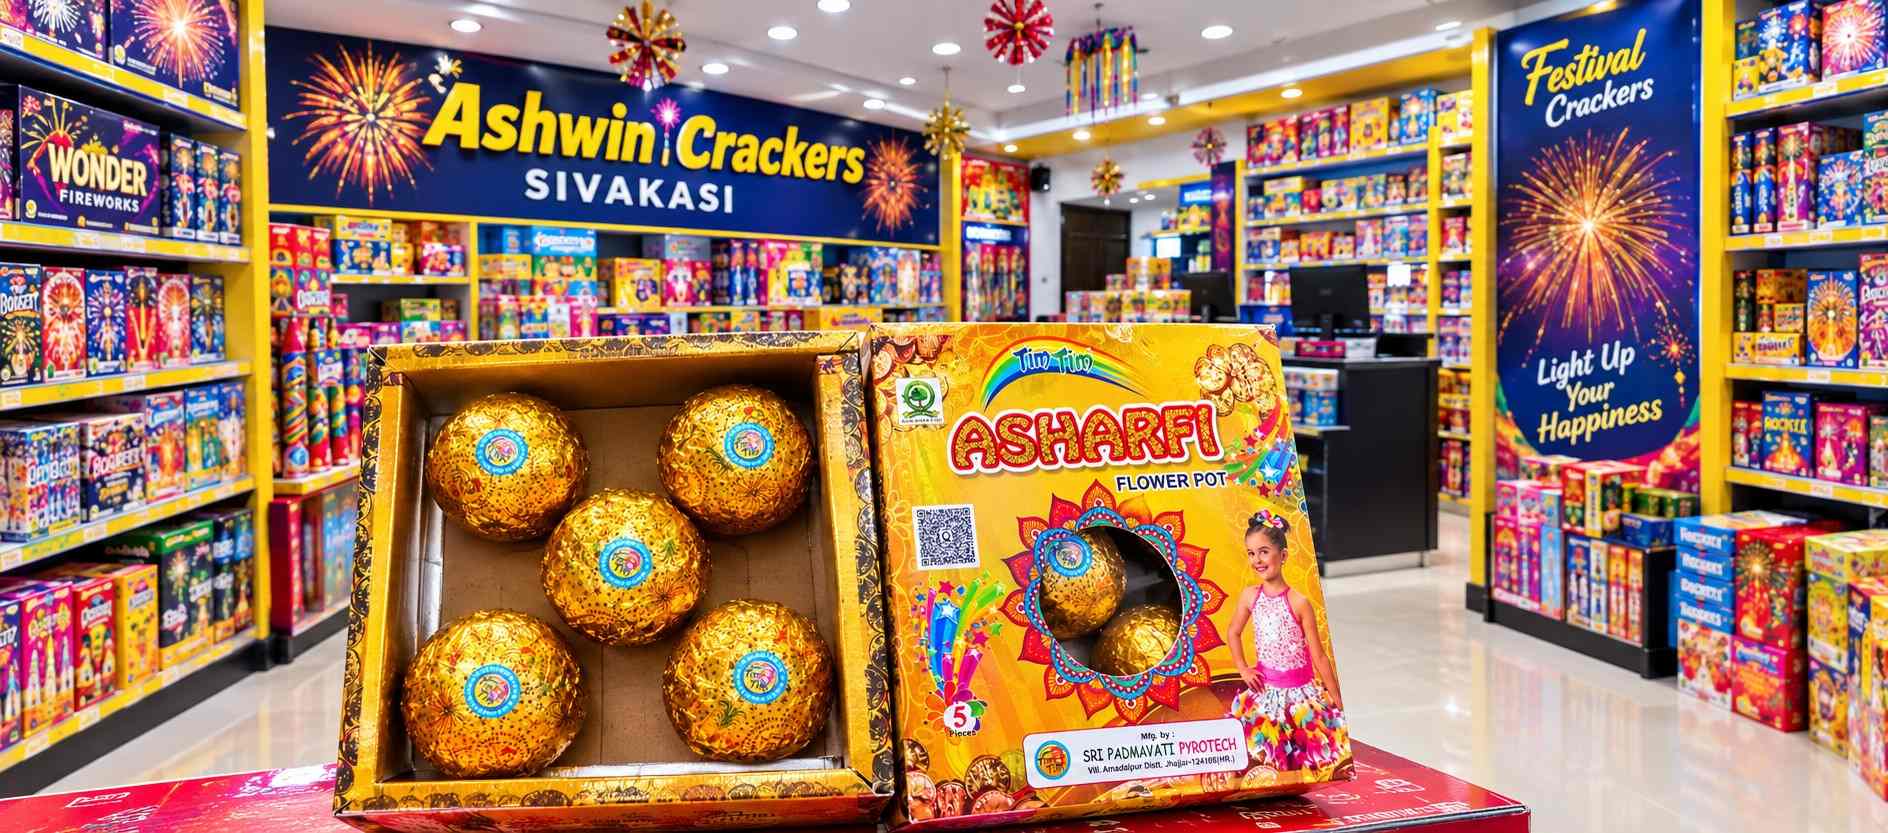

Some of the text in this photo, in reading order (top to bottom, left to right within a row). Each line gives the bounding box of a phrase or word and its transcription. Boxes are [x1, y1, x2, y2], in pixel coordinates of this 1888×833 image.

[1521, 28, 1646, 106] Festival
[1545, 76, 1653, 128] Crackers
[423, 82, 865, 185] Ashwin Crackers
[48, 143, 147, 197] WONDER
[525, 168, 733, 214] SIVAKASI
[60, 189, 140, 213] FIREWORKS
[1537, 340, 1635, 390] Light Up
[1566, 380, 1615, 412] Your
[950, 402, 1224, 473] ASHARFI
[1538, 398, 1663, 447] Happiness
[1116, 471, 1226, 491] FLOWER POT
[953, 705, 967, 728] 5
[1141, 732, 1157, 741] Mfg.
[1160, 731, 1170, 740] by
[1083, 738, 1237, 763] SRI PADMAVATI PYROTECH
